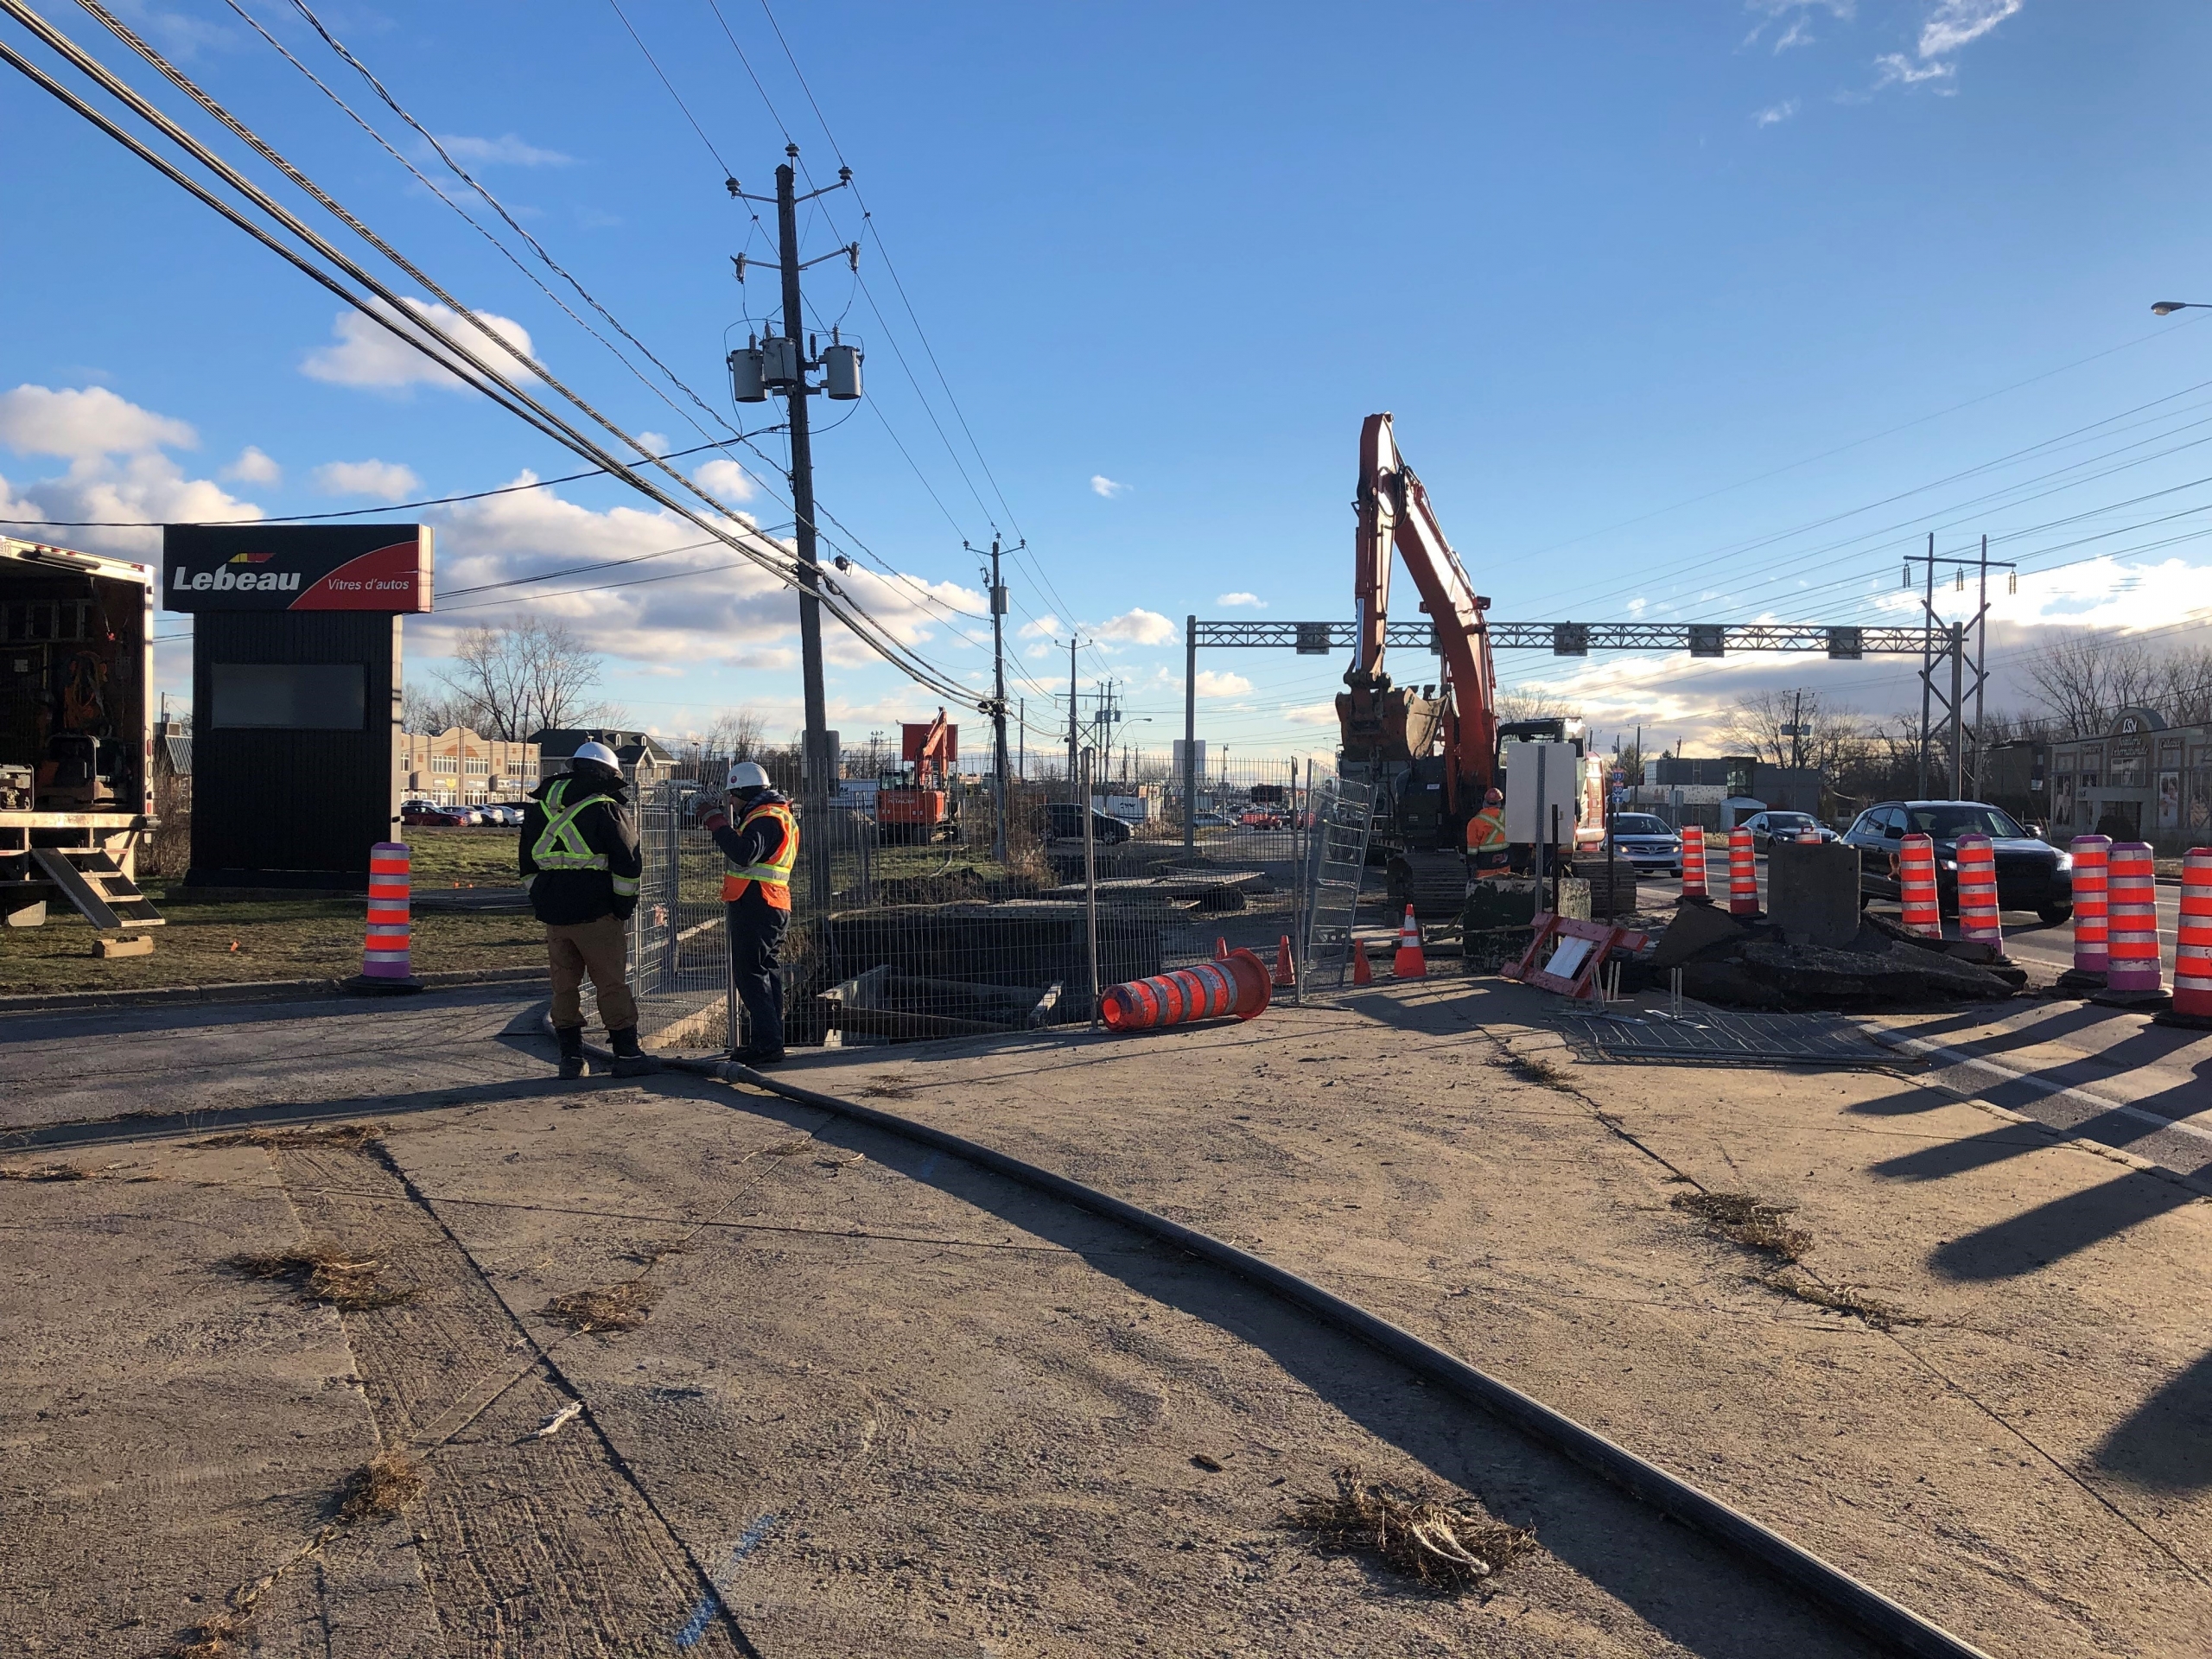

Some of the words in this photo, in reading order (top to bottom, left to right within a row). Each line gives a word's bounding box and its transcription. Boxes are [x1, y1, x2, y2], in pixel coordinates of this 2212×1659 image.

[173, 563, 301, 591] Lebeau
[327, 578, 361, 590] Vitres
[365, 578, 410, 590] d'autos
